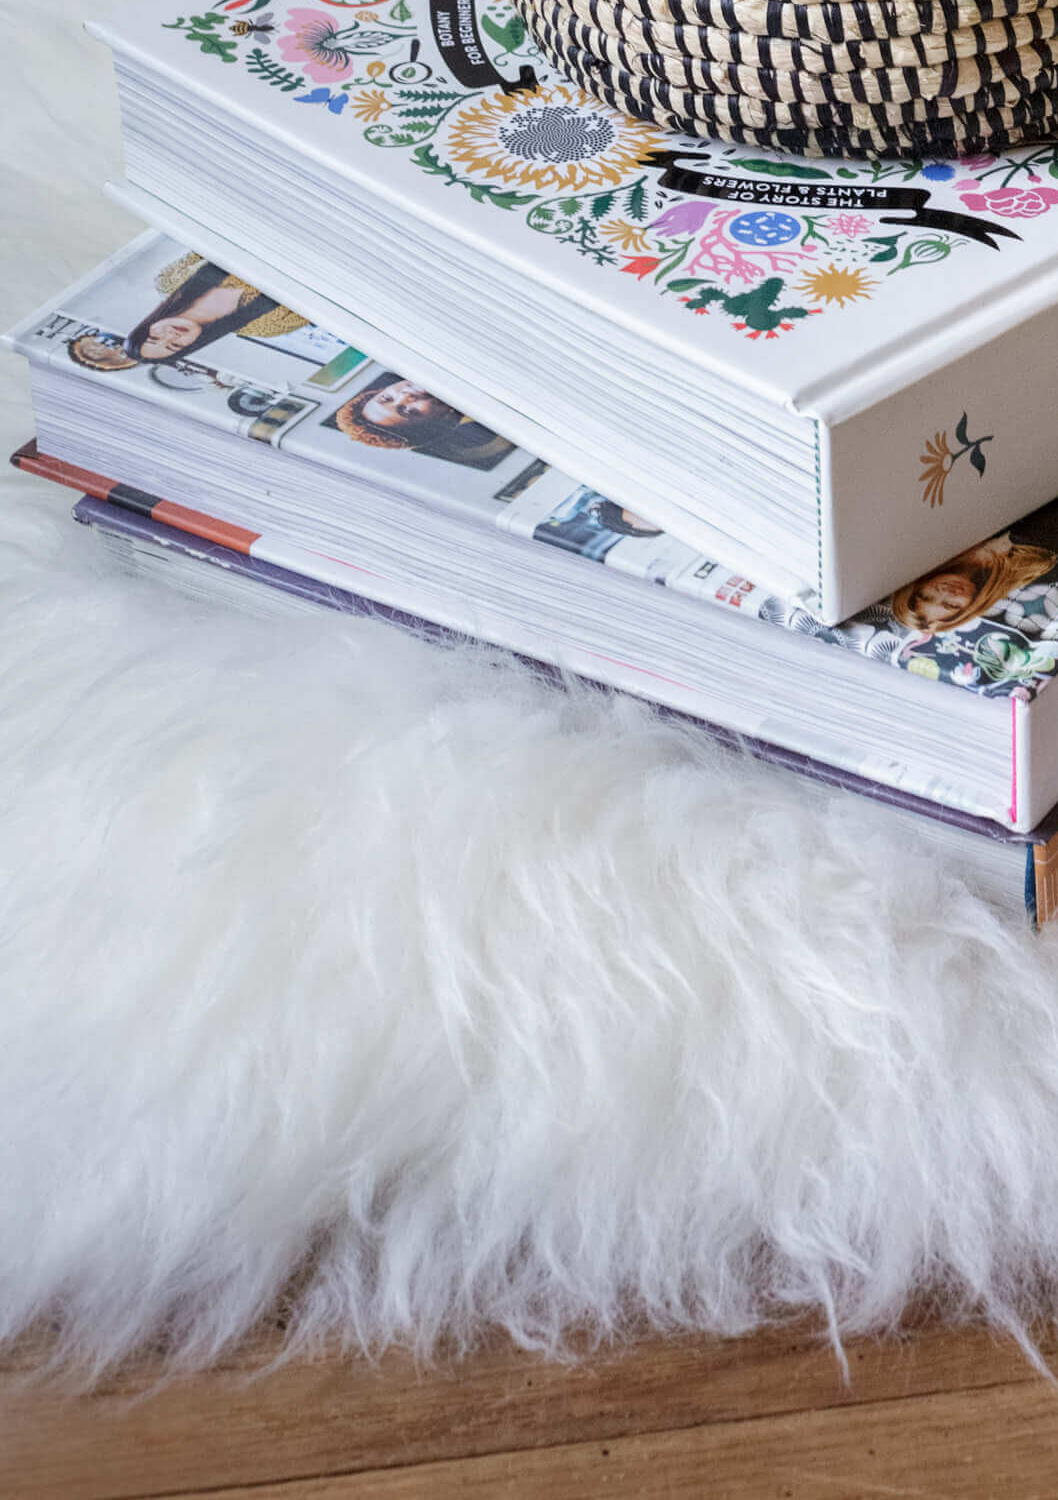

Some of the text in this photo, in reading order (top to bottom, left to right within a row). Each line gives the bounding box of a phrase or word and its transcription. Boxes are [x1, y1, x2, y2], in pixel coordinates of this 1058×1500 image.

[436, 10, 456, 47] BOTANY
[464, 45, 486, 66] FOR
[702, 175, 888, 198] PLANTS & FLOWERS
[727, 191, 865, 208] THE STORY OF
